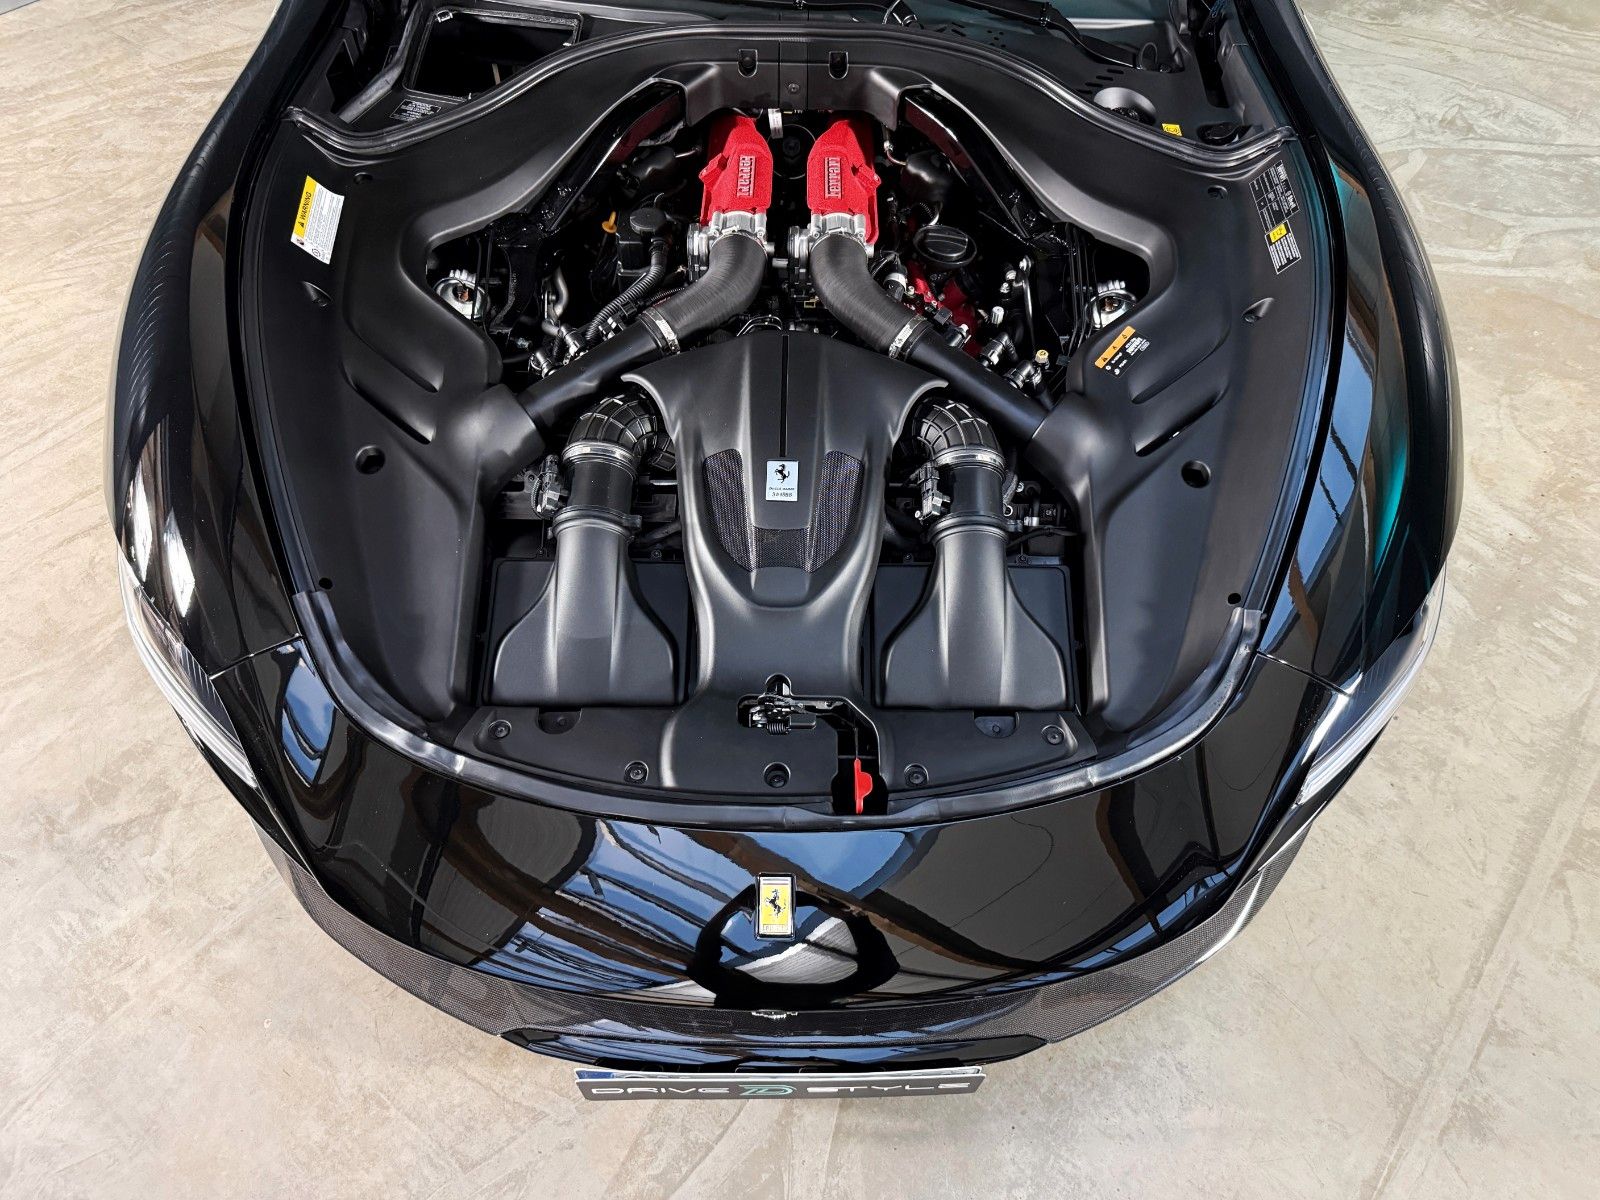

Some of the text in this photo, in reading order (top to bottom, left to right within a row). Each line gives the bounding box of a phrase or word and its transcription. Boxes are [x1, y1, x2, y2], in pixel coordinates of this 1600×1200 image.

[300, 191, 312, 220] WARNING
[591, 1087, 730, 1095] DRIVE
[806, 1082, 971, 1093] STYLE
